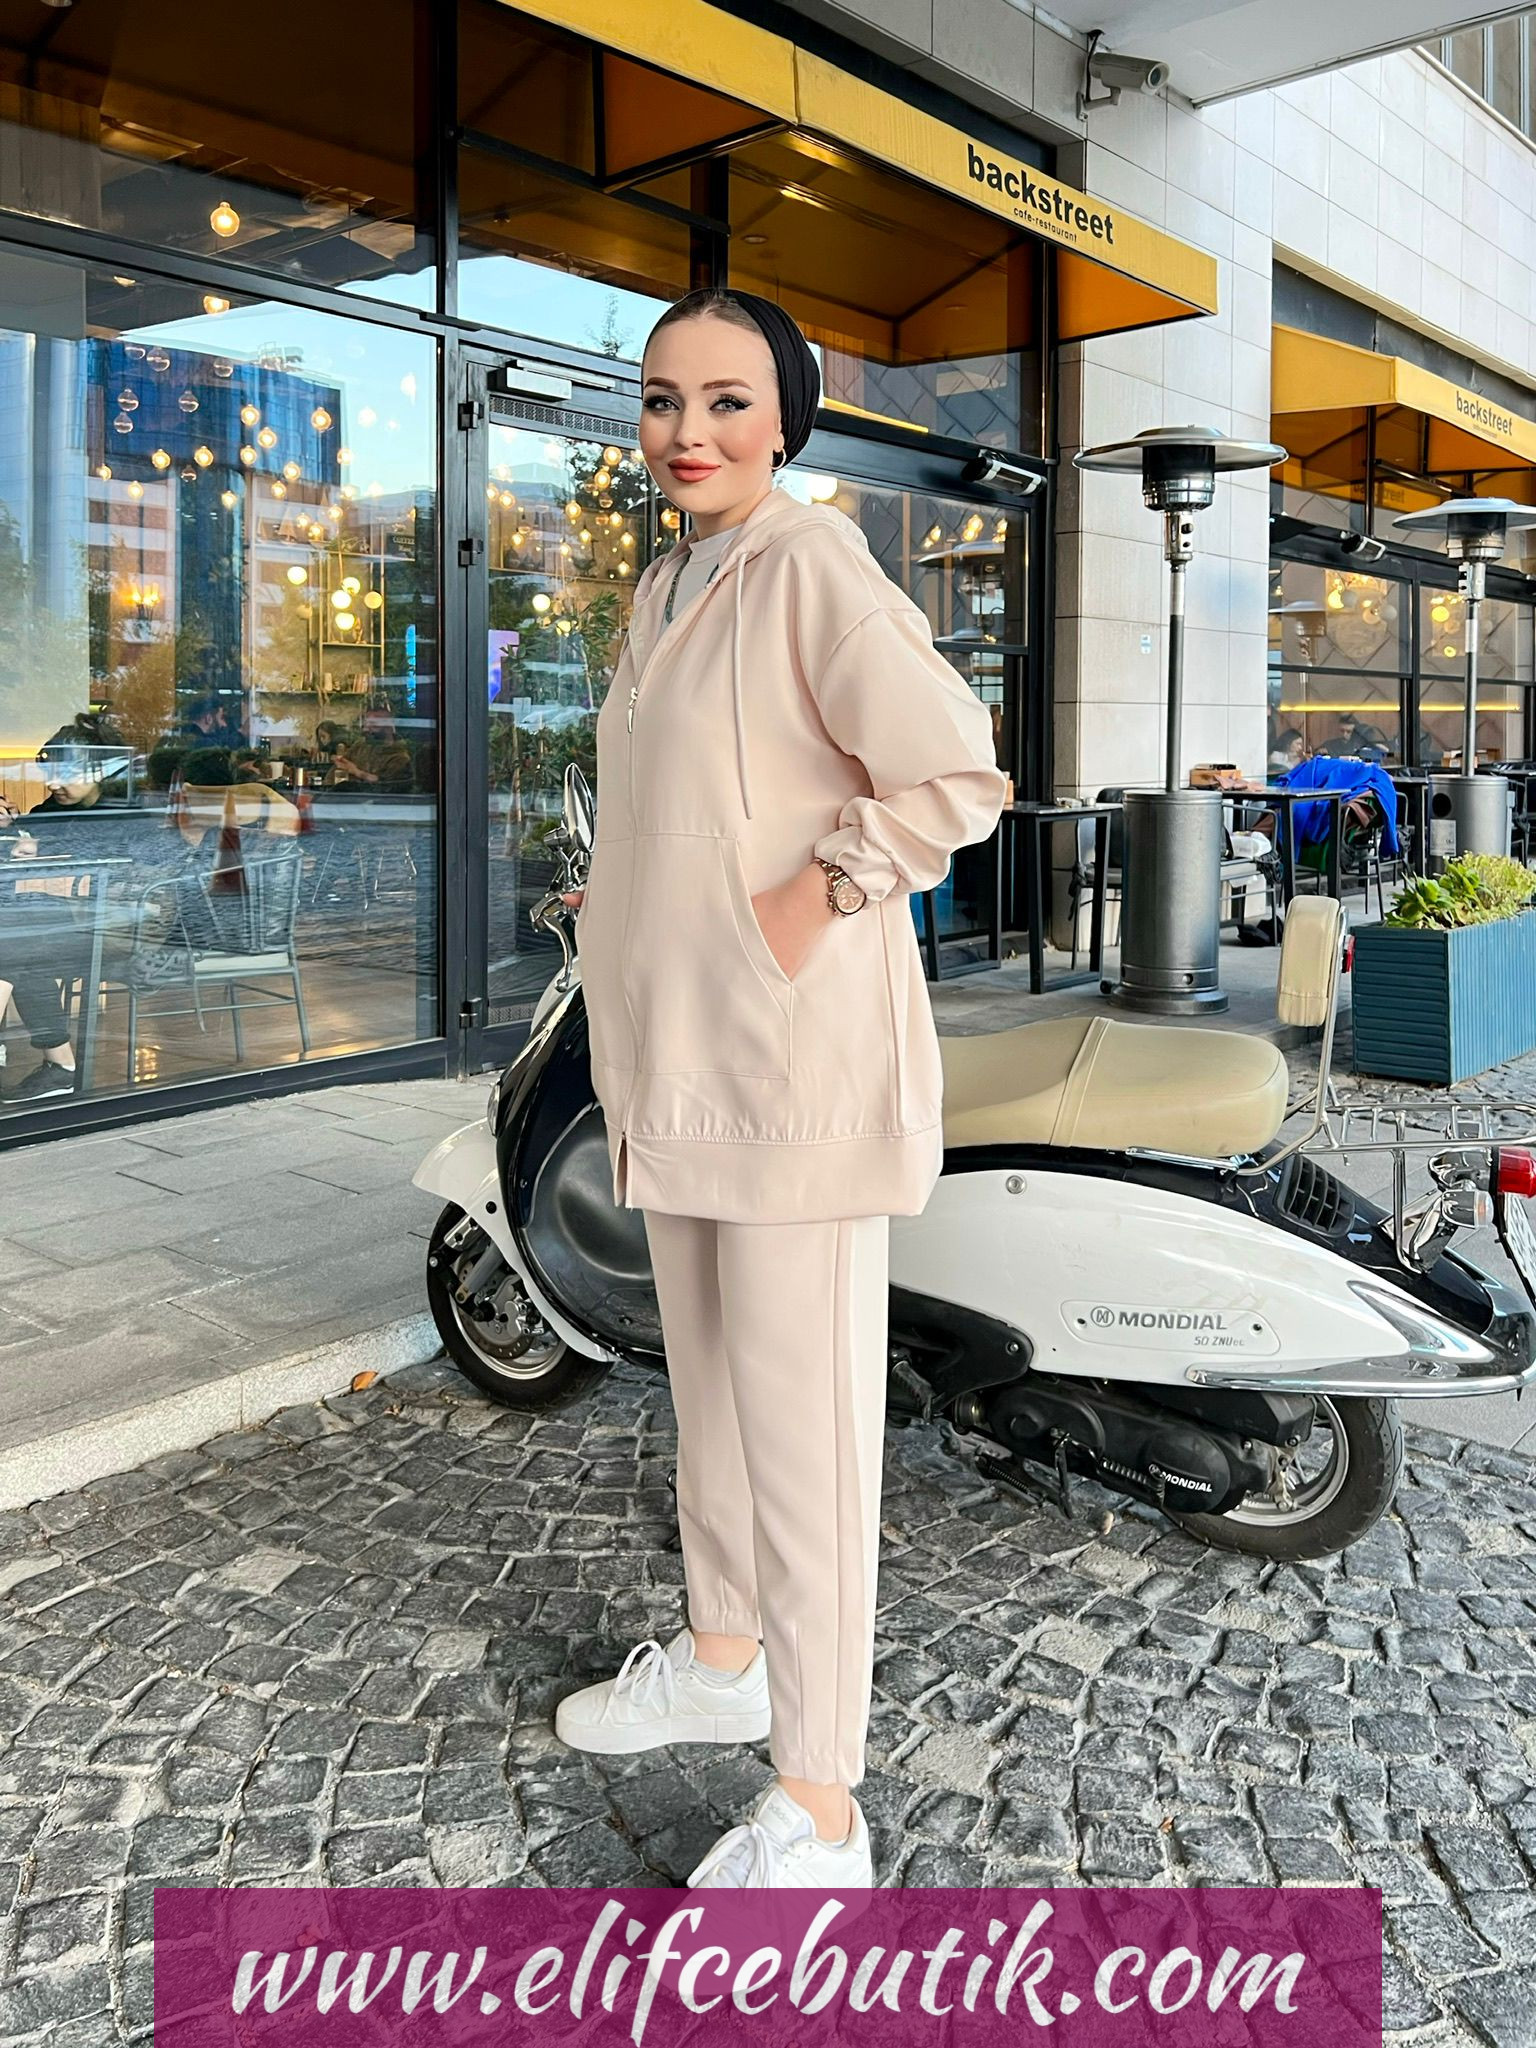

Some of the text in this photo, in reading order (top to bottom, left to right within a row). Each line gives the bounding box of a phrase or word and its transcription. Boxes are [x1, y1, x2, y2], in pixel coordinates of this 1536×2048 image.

[967, 143, 1114, 245] backstreet
[1013, 207, 1077, 243] cafe-restaurant
[1456, 391, 1513, 436] backstreet
[1118, 1311, 1228, 1330] MONDIAL
[1160, 1471, 1213, 1493] MONDIAL
